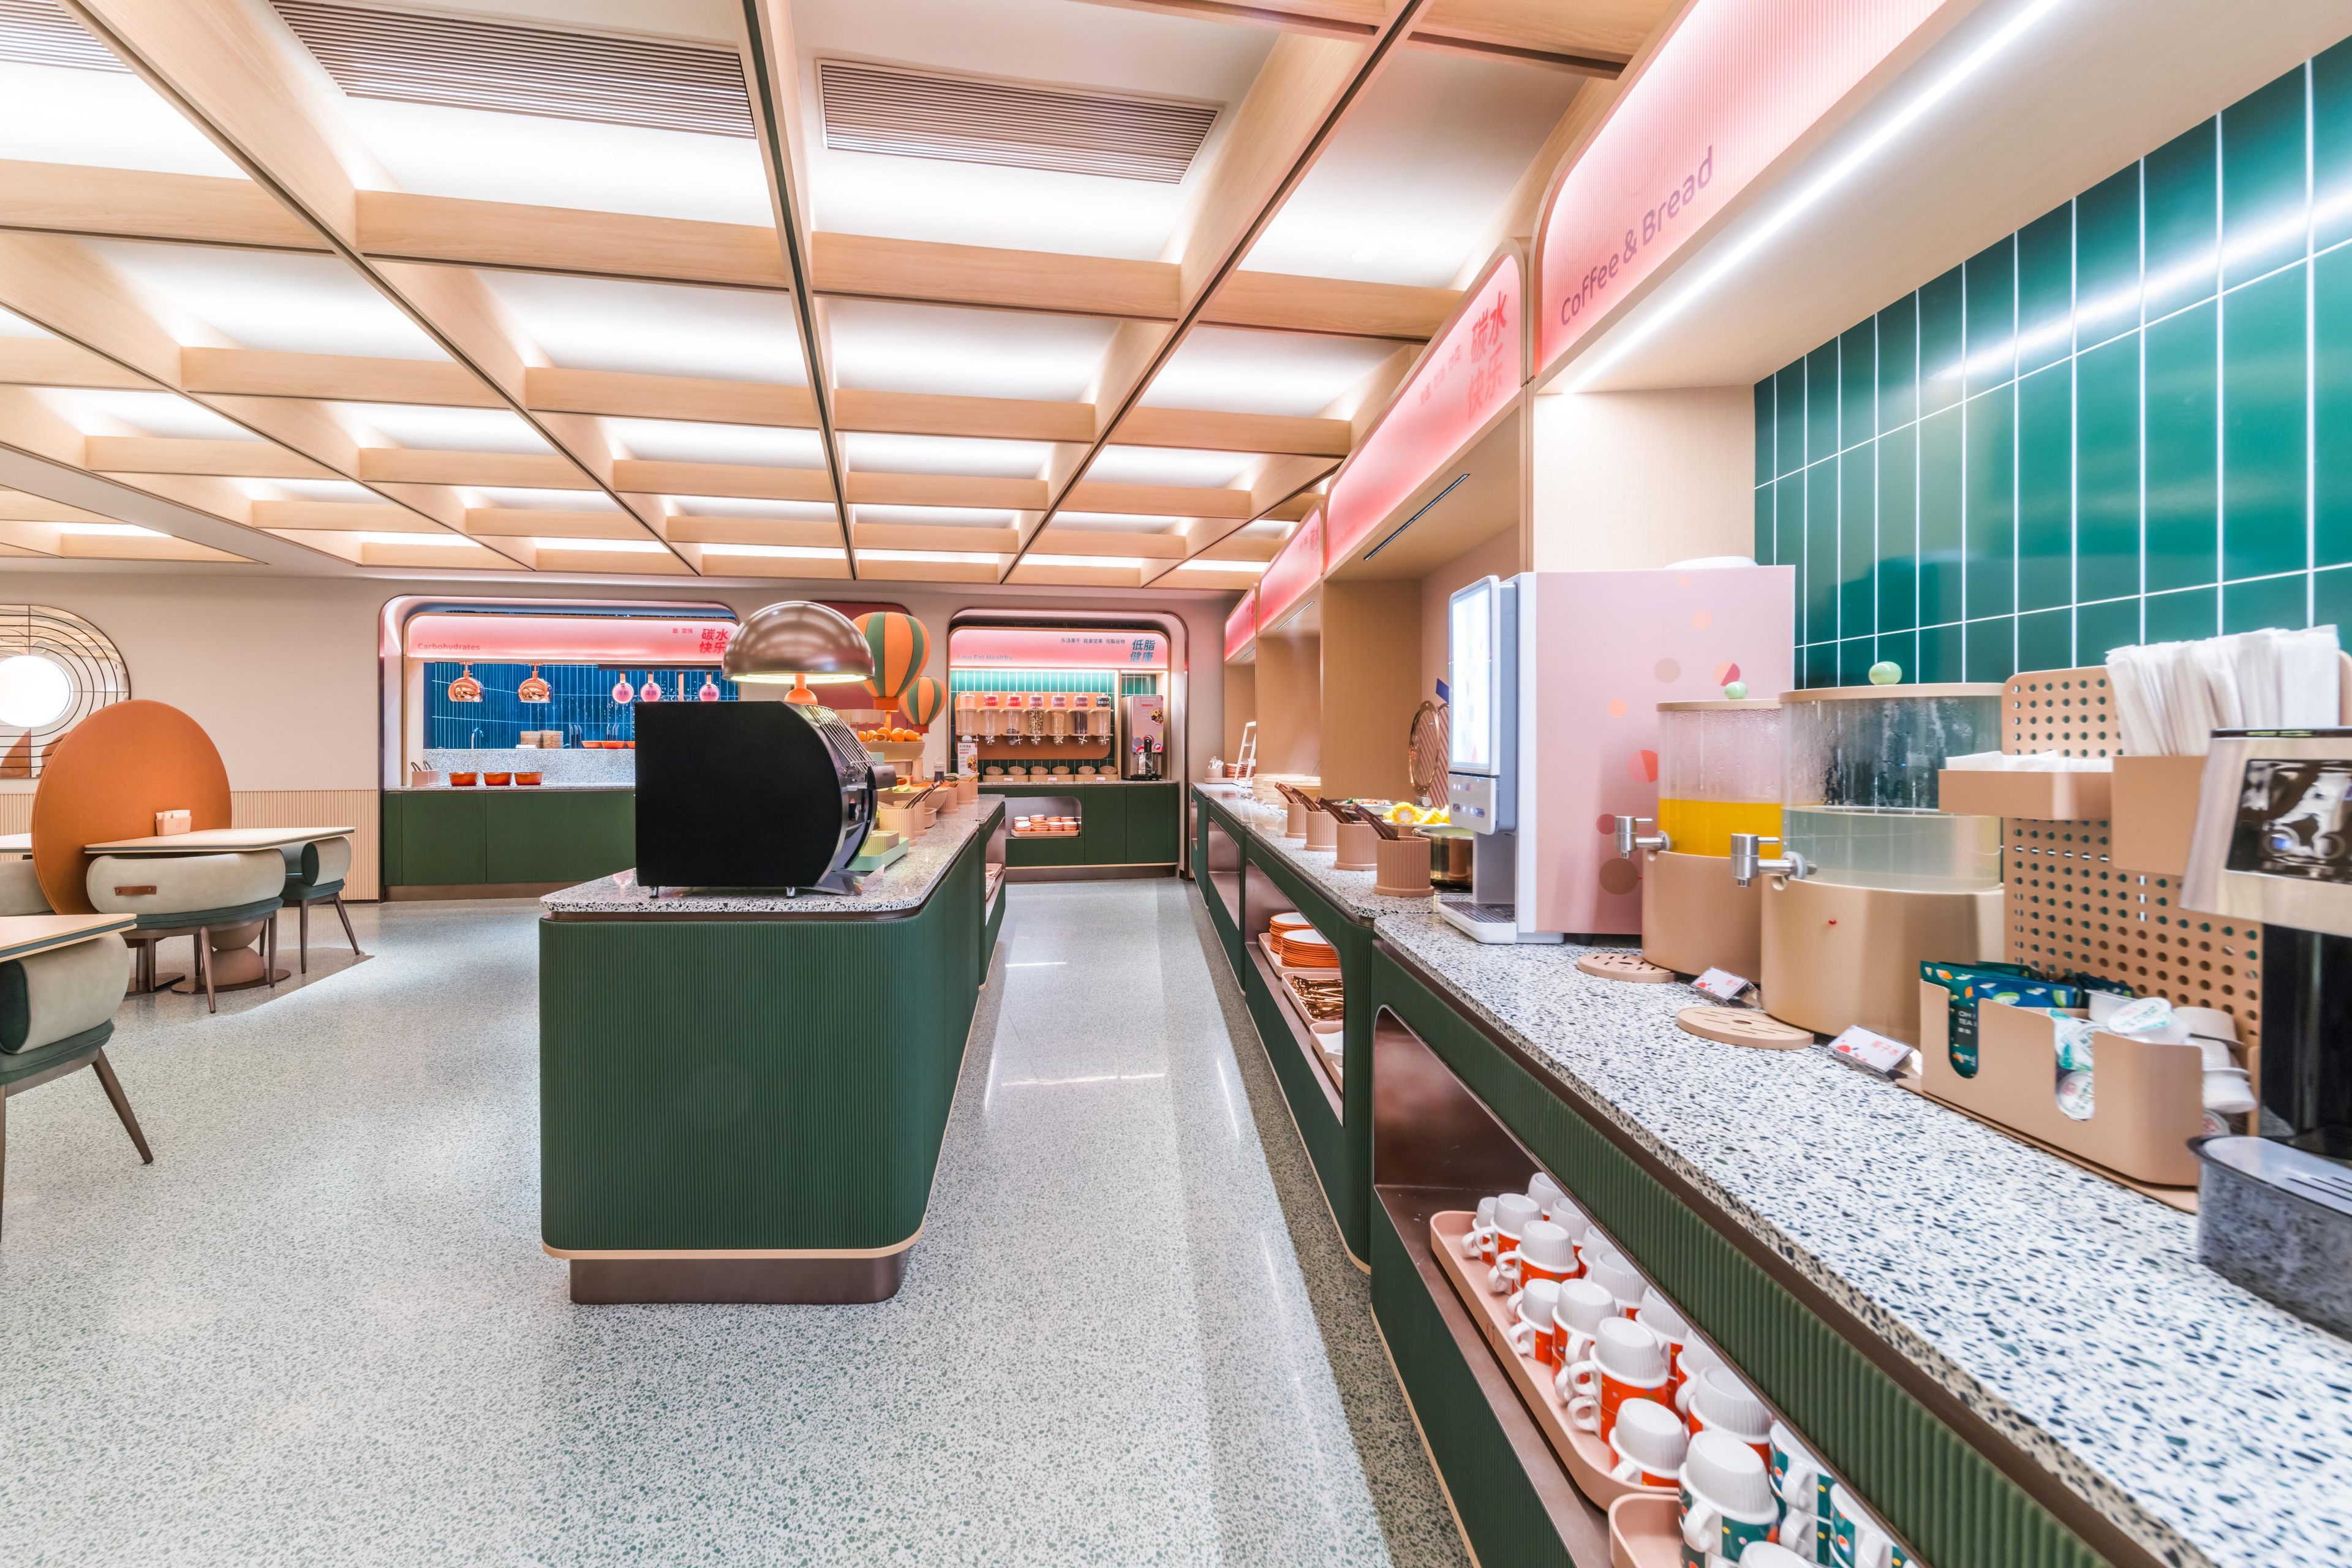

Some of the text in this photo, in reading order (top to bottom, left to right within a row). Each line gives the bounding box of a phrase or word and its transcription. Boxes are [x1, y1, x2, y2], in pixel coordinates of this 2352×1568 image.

[1560, 145, 1714, 326] Coffee & Bread
[1471, 290, 1509, 364] 碳水
[1468, 342, 1504, 421] 快乐
[701, 628, 729, 641] 碳水
[699, 642, 726, 654] 快乐
[1132, 639, 1156, 650] 低脂
[1130, 651, 1154, 663] 健康
